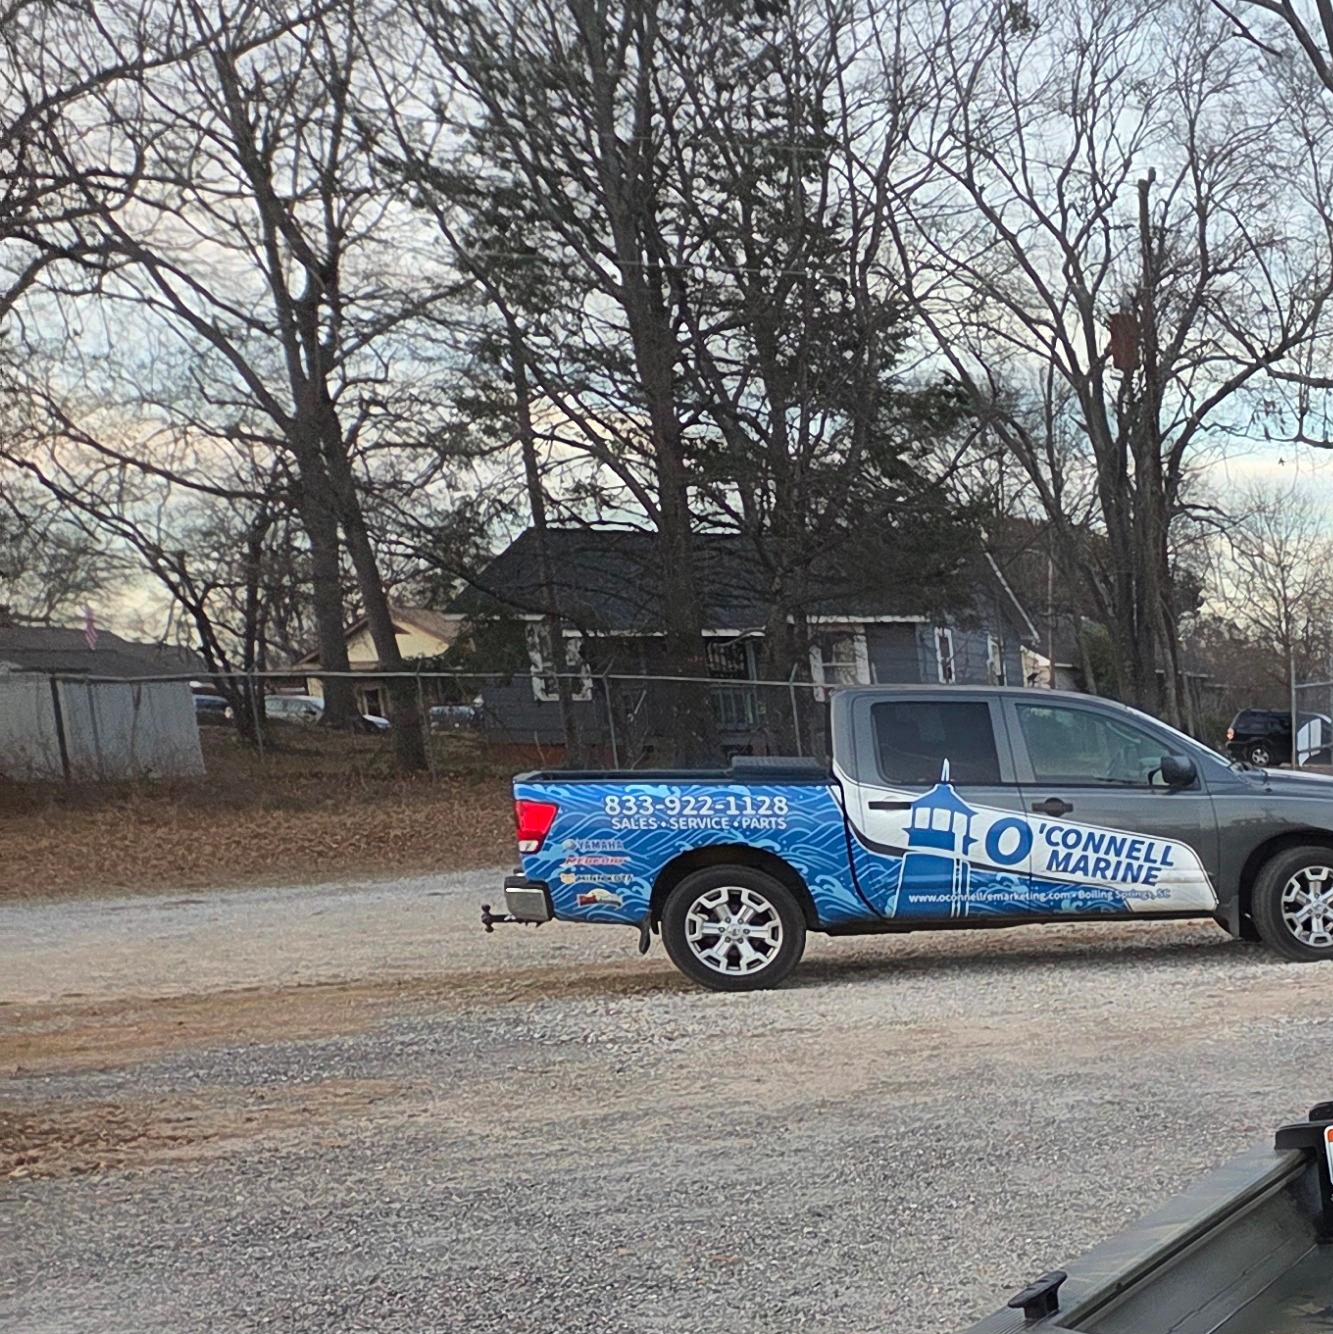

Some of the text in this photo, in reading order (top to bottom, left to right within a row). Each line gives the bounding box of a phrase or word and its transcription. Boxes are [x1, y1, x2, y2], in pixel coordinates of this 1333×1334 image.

[604, 795, 789, 816] 833-922-1128
[611, 816, 787, 830] SALES SERVICE PARTS
[578, 840, 624, 850] YAMAHA
[1046, 849, 1163, 887] MARINE
[1077, 888, 1113, 901] Boiling
